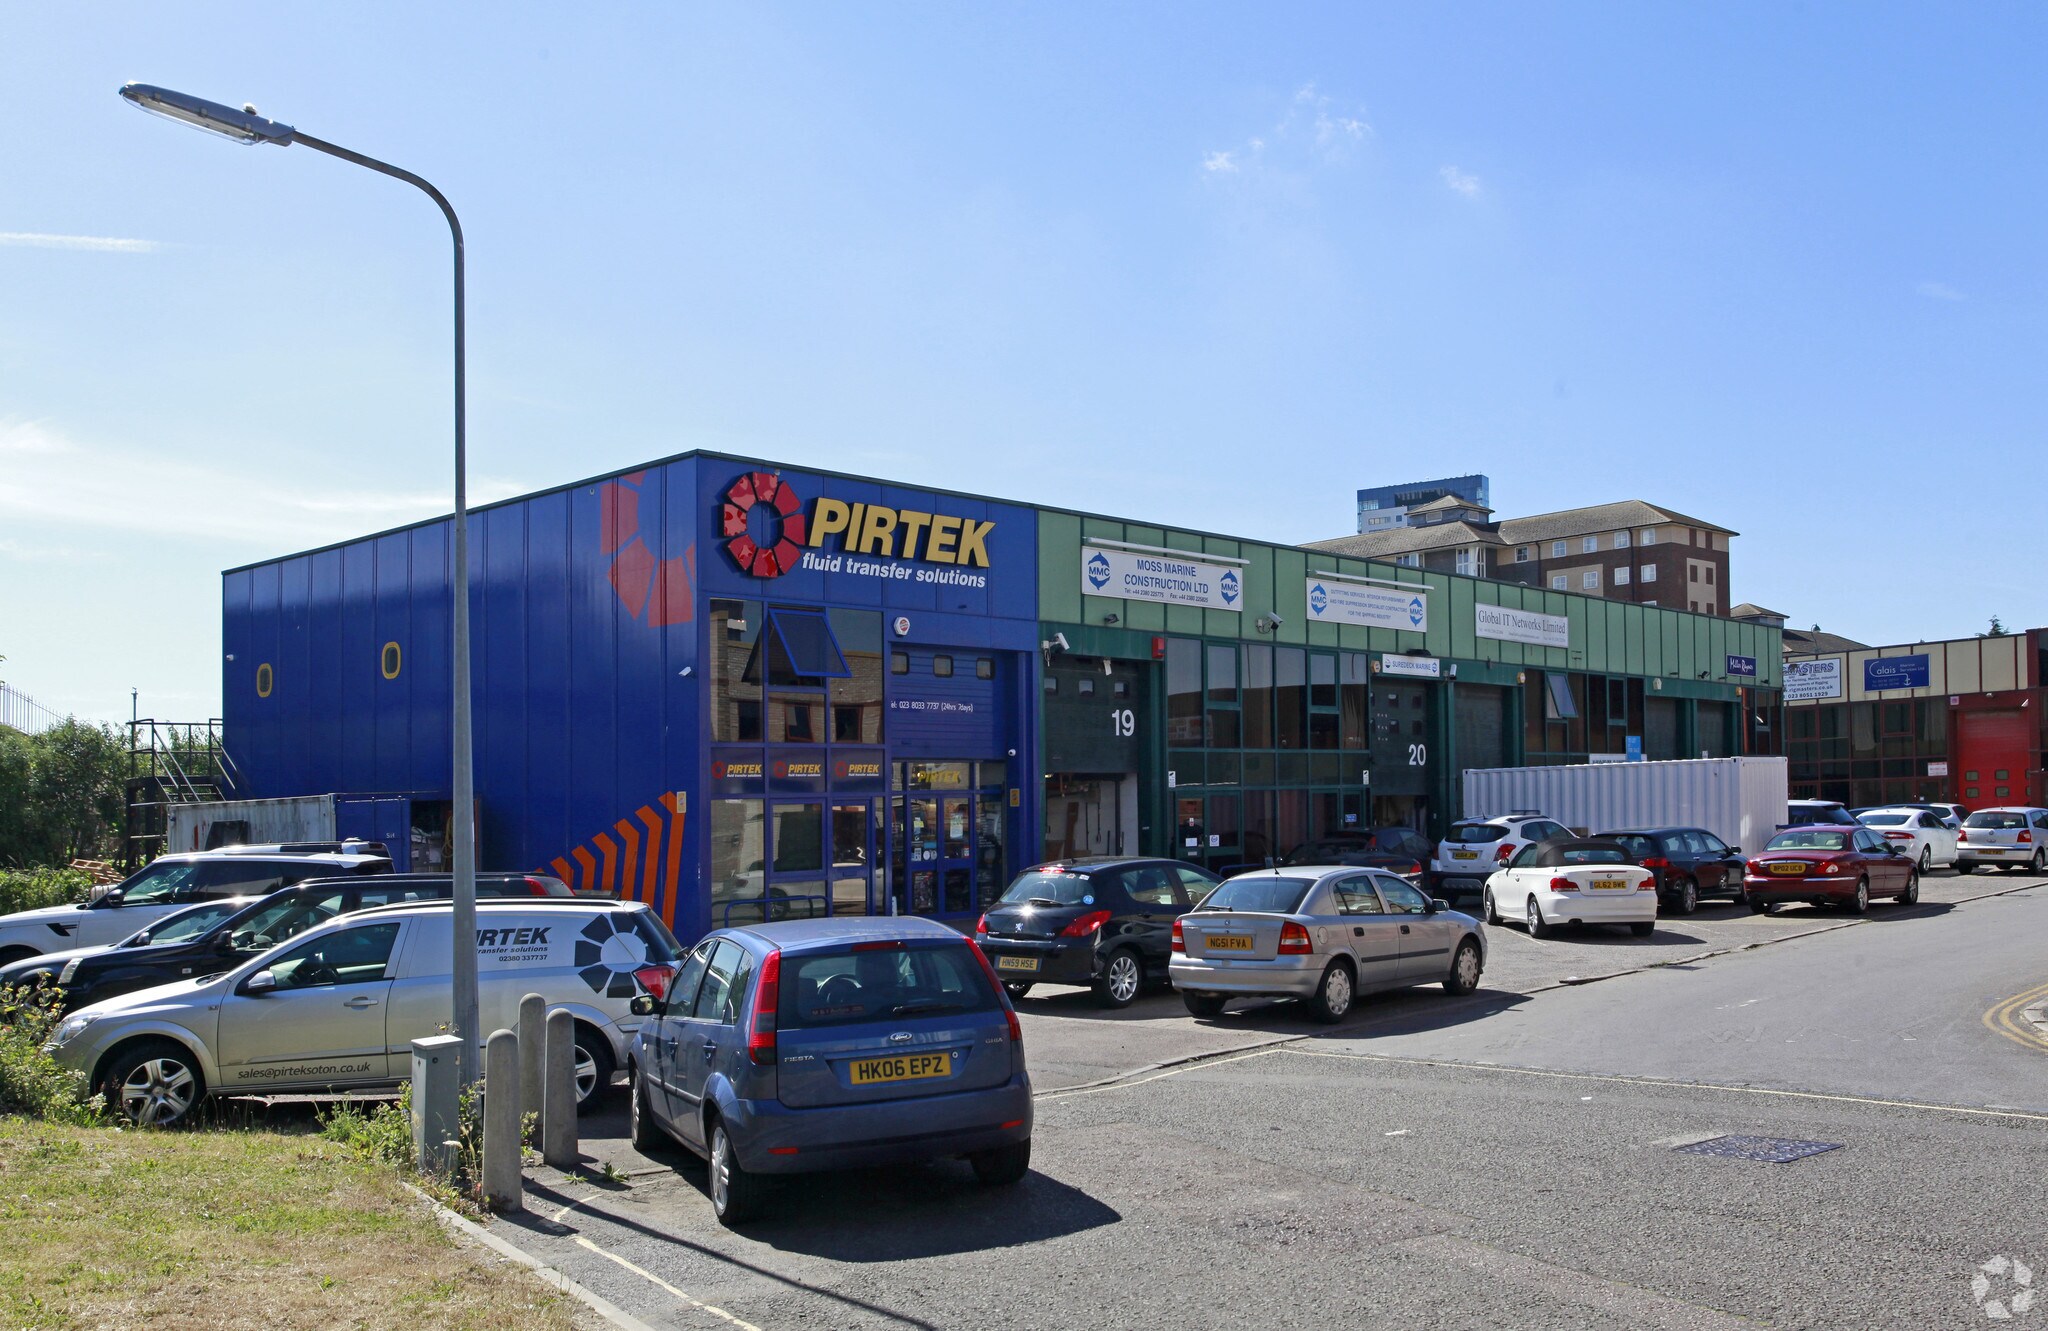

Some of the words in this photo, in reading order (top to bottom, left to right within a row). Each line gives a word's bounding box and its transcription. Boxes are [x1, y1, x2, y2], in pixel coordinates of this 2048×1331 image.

[809, 497, 996, 568] PIRTEK
[803, 552, 841, 573] fluid
[846, 558, 912, 580] transfer
[916, 567, 986, 588] solutions
[1088, 566, 1110, 577] MMC
[1137, 559, 1162, 573] MOSS
[1165, 564, 1196, 577] MARINE
[1124, 574, 1192, 593] CONSTRUCTION
[1194, 583, 1209, 594] LTD
[1221, 583, 1239, 592] MMC
[1311, 596, 1326, 604] MMC
[1410, 607, 1423, 616] MMC
[1478, 609, 1500, 625] Global
[1502, 613, 1510, 626] IT
[1511, 615, 1542, 631] Networks
[1542, 619, 1565, 634] Limited
[1869, 660, 1897, 677] Calais
[898, 700, 909, 709] 023
[911, 701, 925, 709] 8033
[926, 702, 940, 710] 7737
[1112, 709, 1135, 737] 19
[1408, 743, 1426, 766] 20
[727, 764, 762, 774] PIRTEK
[788, 763, 821, 773] PIRTEK
[848, 763, 879, 773] PIRTEK
[918, 770, 960, 784] PIRTEK
[476, 927, 552, 946] IRTEK
[1210, 938, 1229, 948] NG51
[1230, 938, 1247, 948] FVA
[476, 946, 509, 954] ransfer
[510, 946, 548, 954] solutions
[1020, 958, 1034, 969] HSE
[784, 1055, 815, 1063] FIESTA
[237, 1061, 371, 1079] sales@pirteksoton.co.uk
[859, 1060, 906, 1081] HK06
[910, 1056, 944, 1076] EPZ
